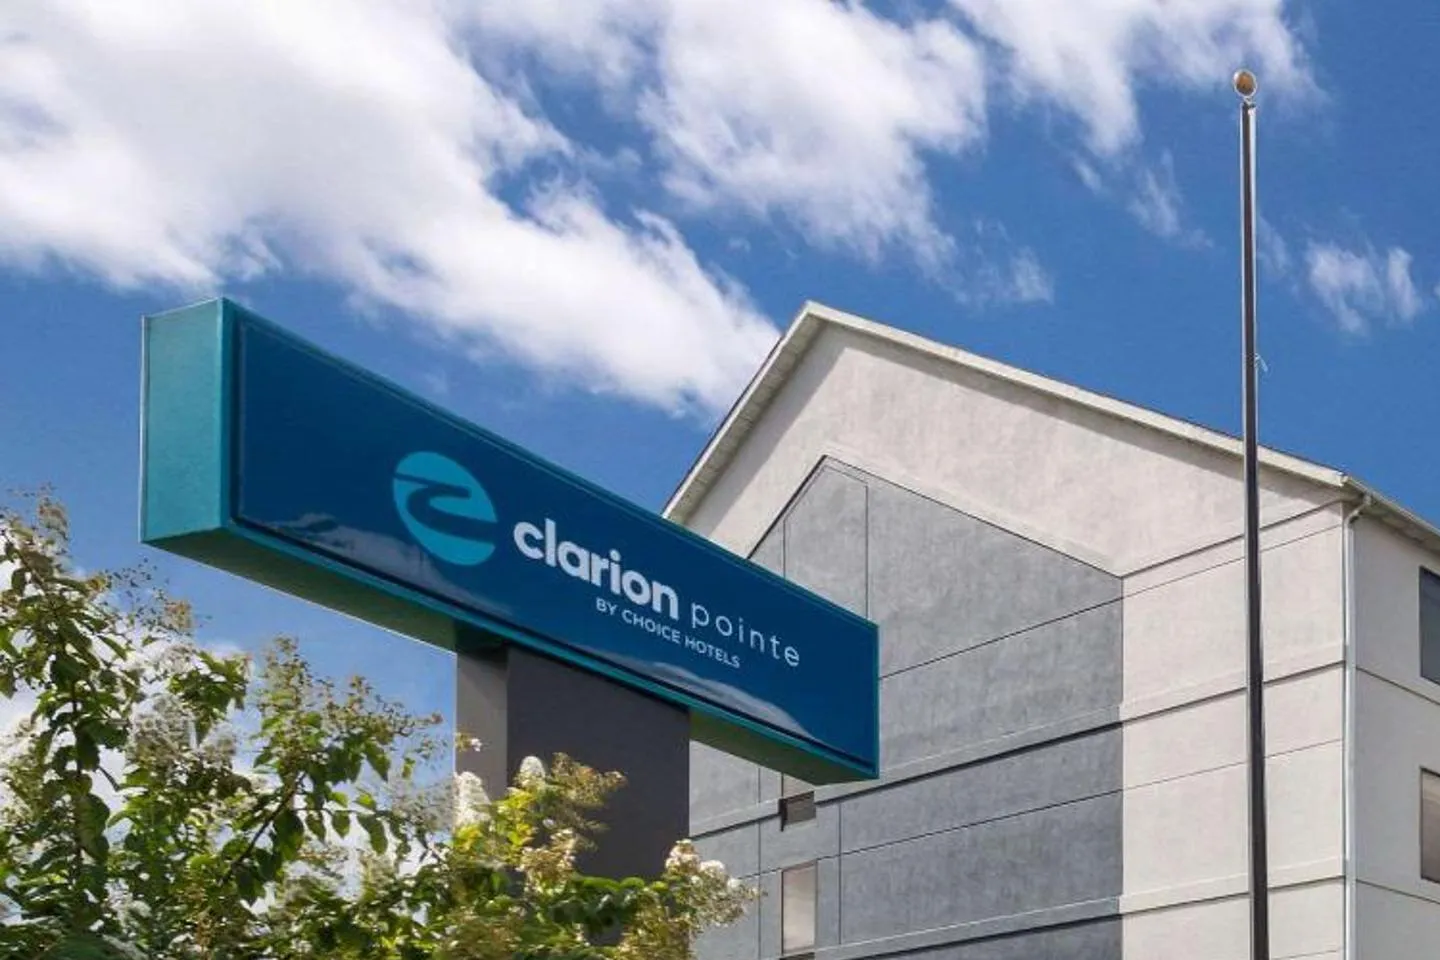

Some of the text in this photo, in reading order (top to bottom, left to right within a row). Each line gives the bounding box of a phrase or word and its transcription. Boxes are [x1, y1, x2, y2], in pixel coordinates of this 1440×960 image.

[513, 518, 799, 667] clarion pointe
[596, 597, 740, 668] BY CHOICE HOTELS
